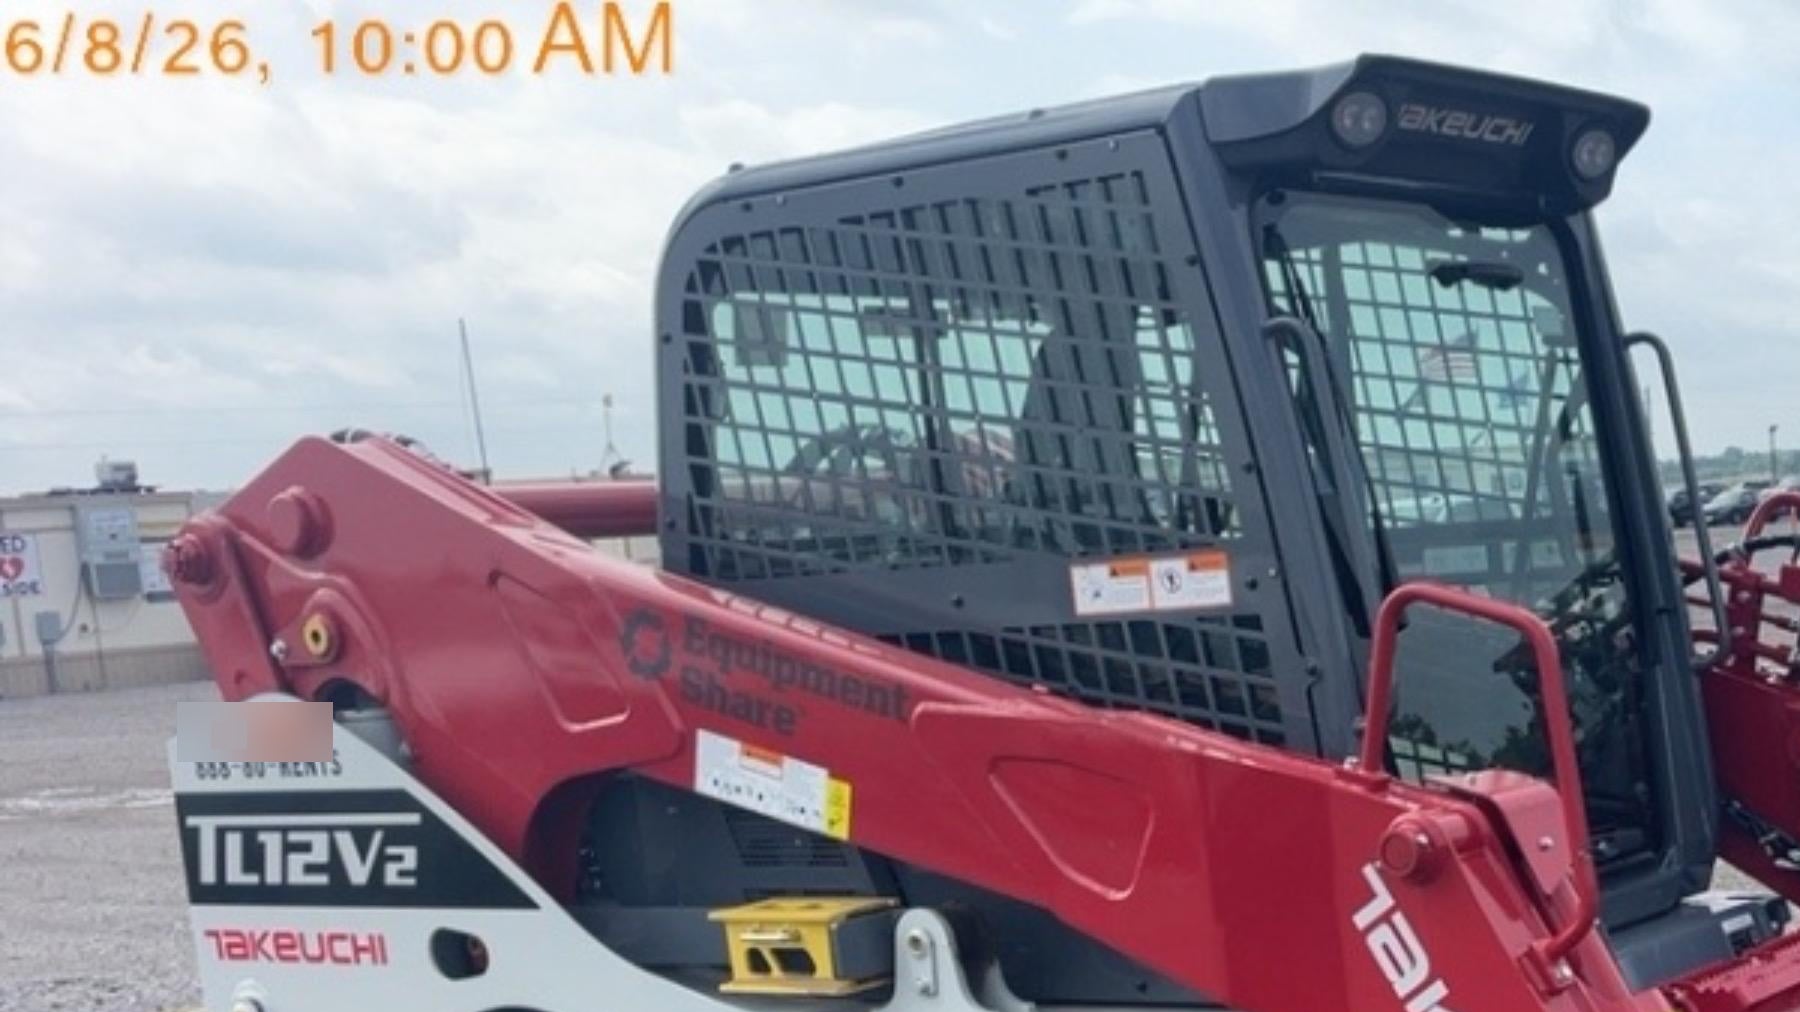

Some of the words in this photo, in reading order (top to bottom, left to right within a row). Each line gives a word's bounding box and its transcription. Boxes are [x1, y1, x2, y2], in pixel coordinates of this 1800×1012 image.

[679, 664, 798, 734] Share
[683, 611, 909, 722] Equipment
[186, 812, 422, 886] TL12V2
[203, 927, 389, 966] TAKEUCHI
